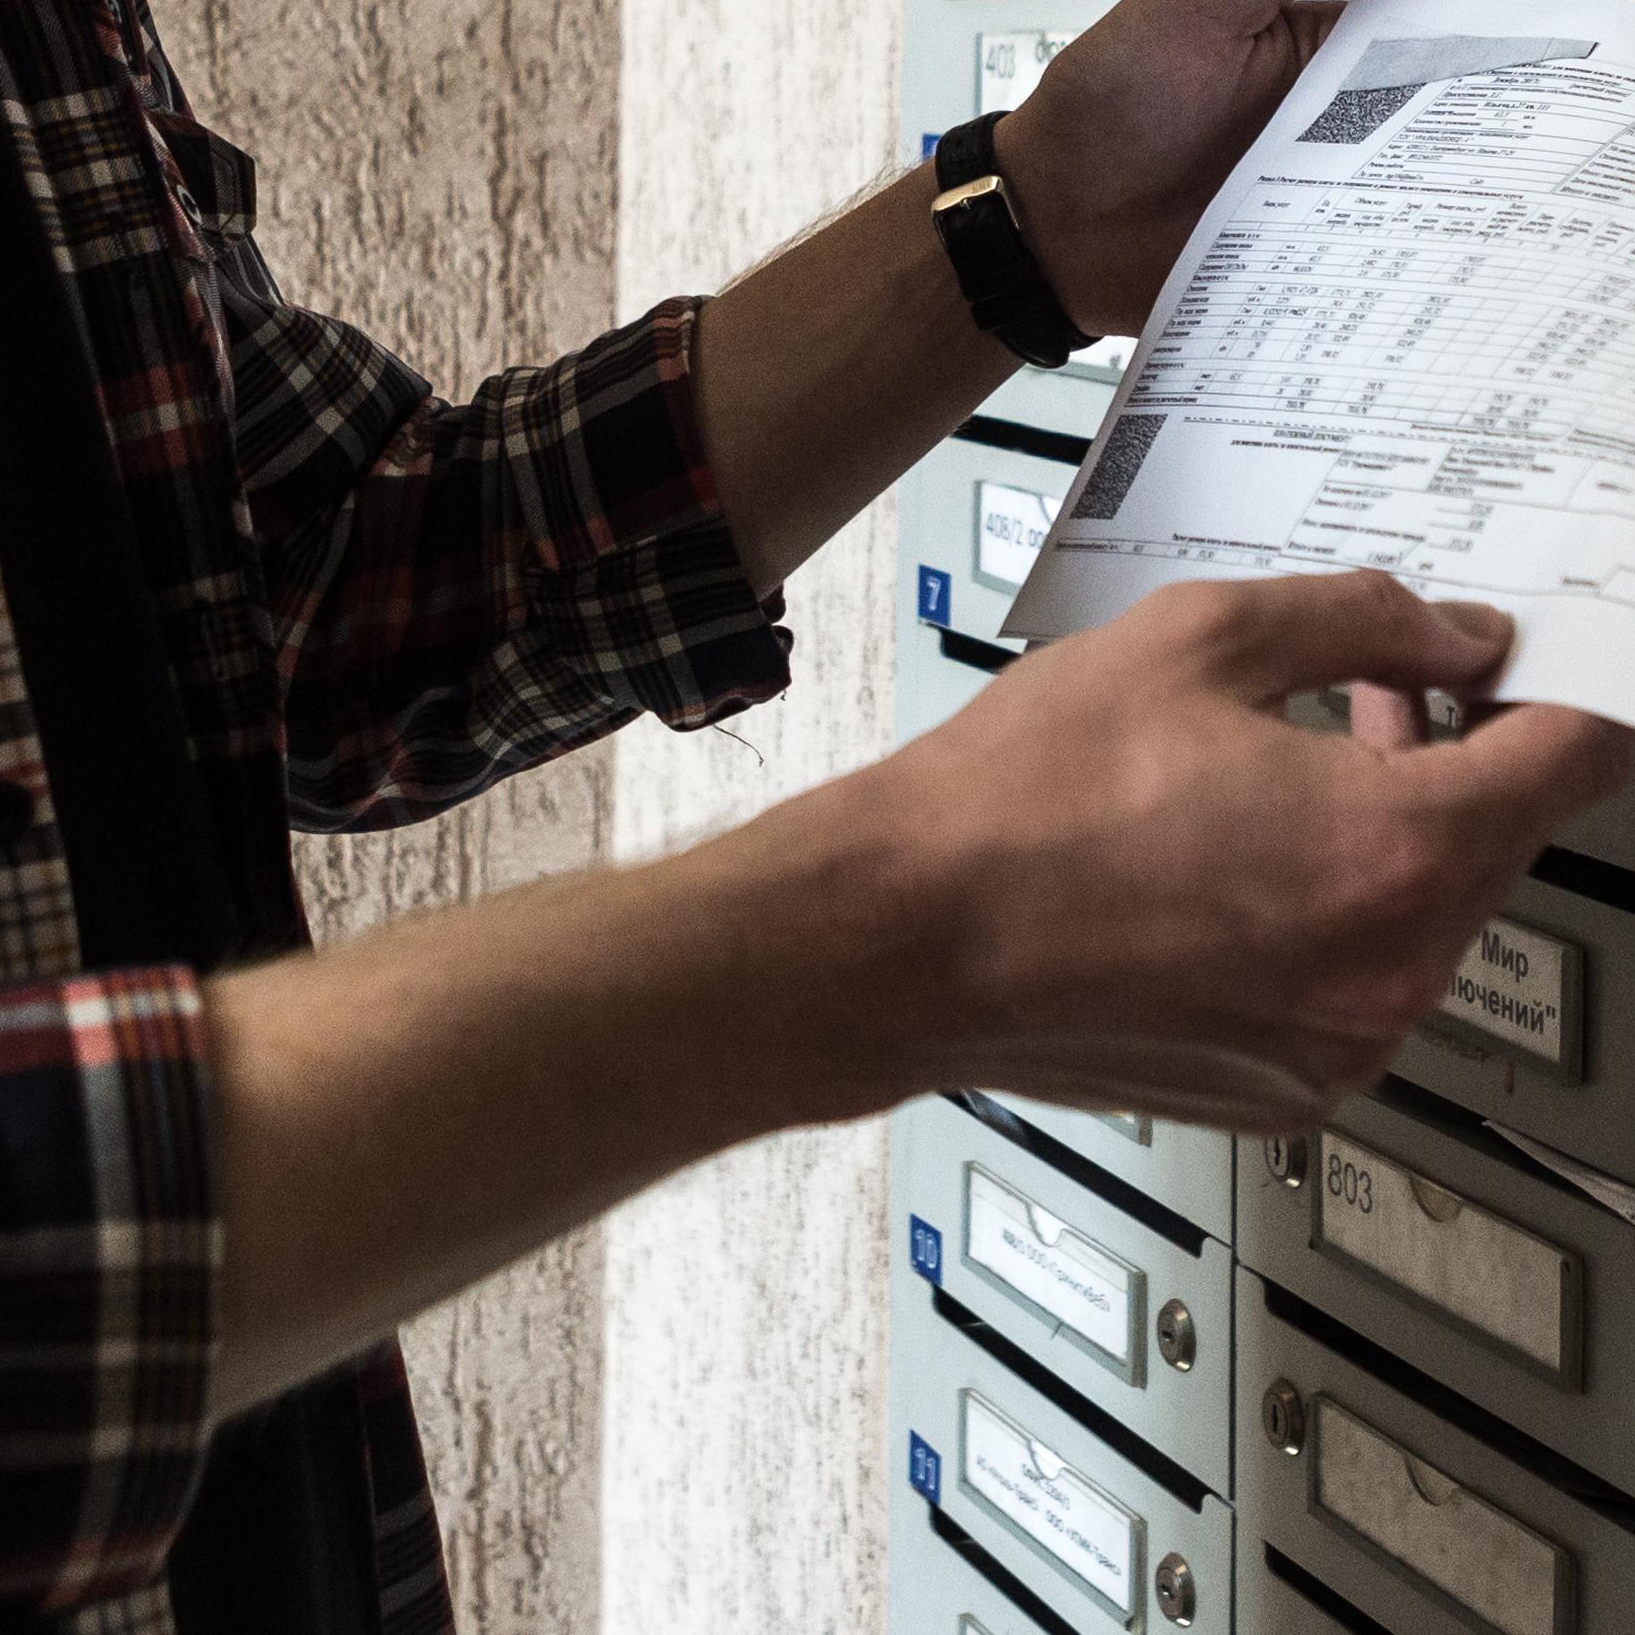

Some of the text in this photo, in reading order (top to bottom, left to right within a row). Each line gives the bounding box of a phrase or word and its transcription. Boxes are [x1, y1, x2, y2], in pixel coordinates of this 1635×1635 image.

[926, 576, 942, 611] 7
[1481, 929, 1529, 978] Мир
[1327, 1153, 1374, 1214] 803
